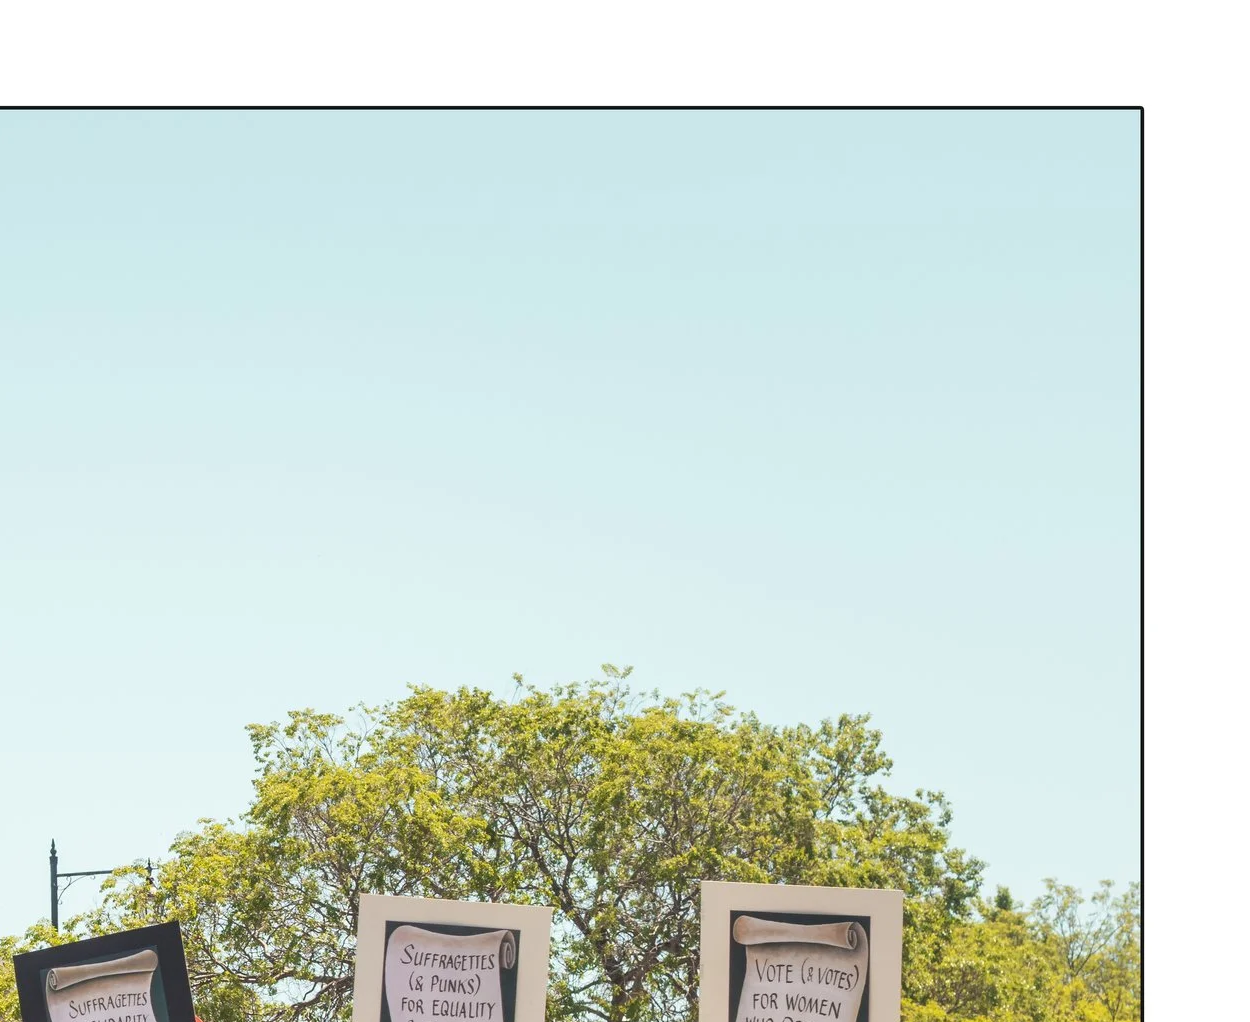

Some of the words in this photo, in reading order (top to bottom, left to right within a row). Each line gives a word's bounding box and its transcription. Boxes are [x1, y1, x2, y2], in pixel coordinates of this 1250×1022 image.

[400, 943, 495, 970] SUFFRAGETTES
[408, 971, 424, 992] (&
[431, 974, 481, 997] PUNKS)
[755, 958, 794, 984] VOTE
[801, 957, 814, 985] (&
[818, 964, 860, 992] VOTES)
[68, 991, 148, 1019] SUFFRAGETTES
[401, 997, 425, 1015] FOR
[432, 999, 496, 1020] EQUALITY
[753, 993, 778, 1010] FOR
[786, 993, 842, 1019] WOMEN
